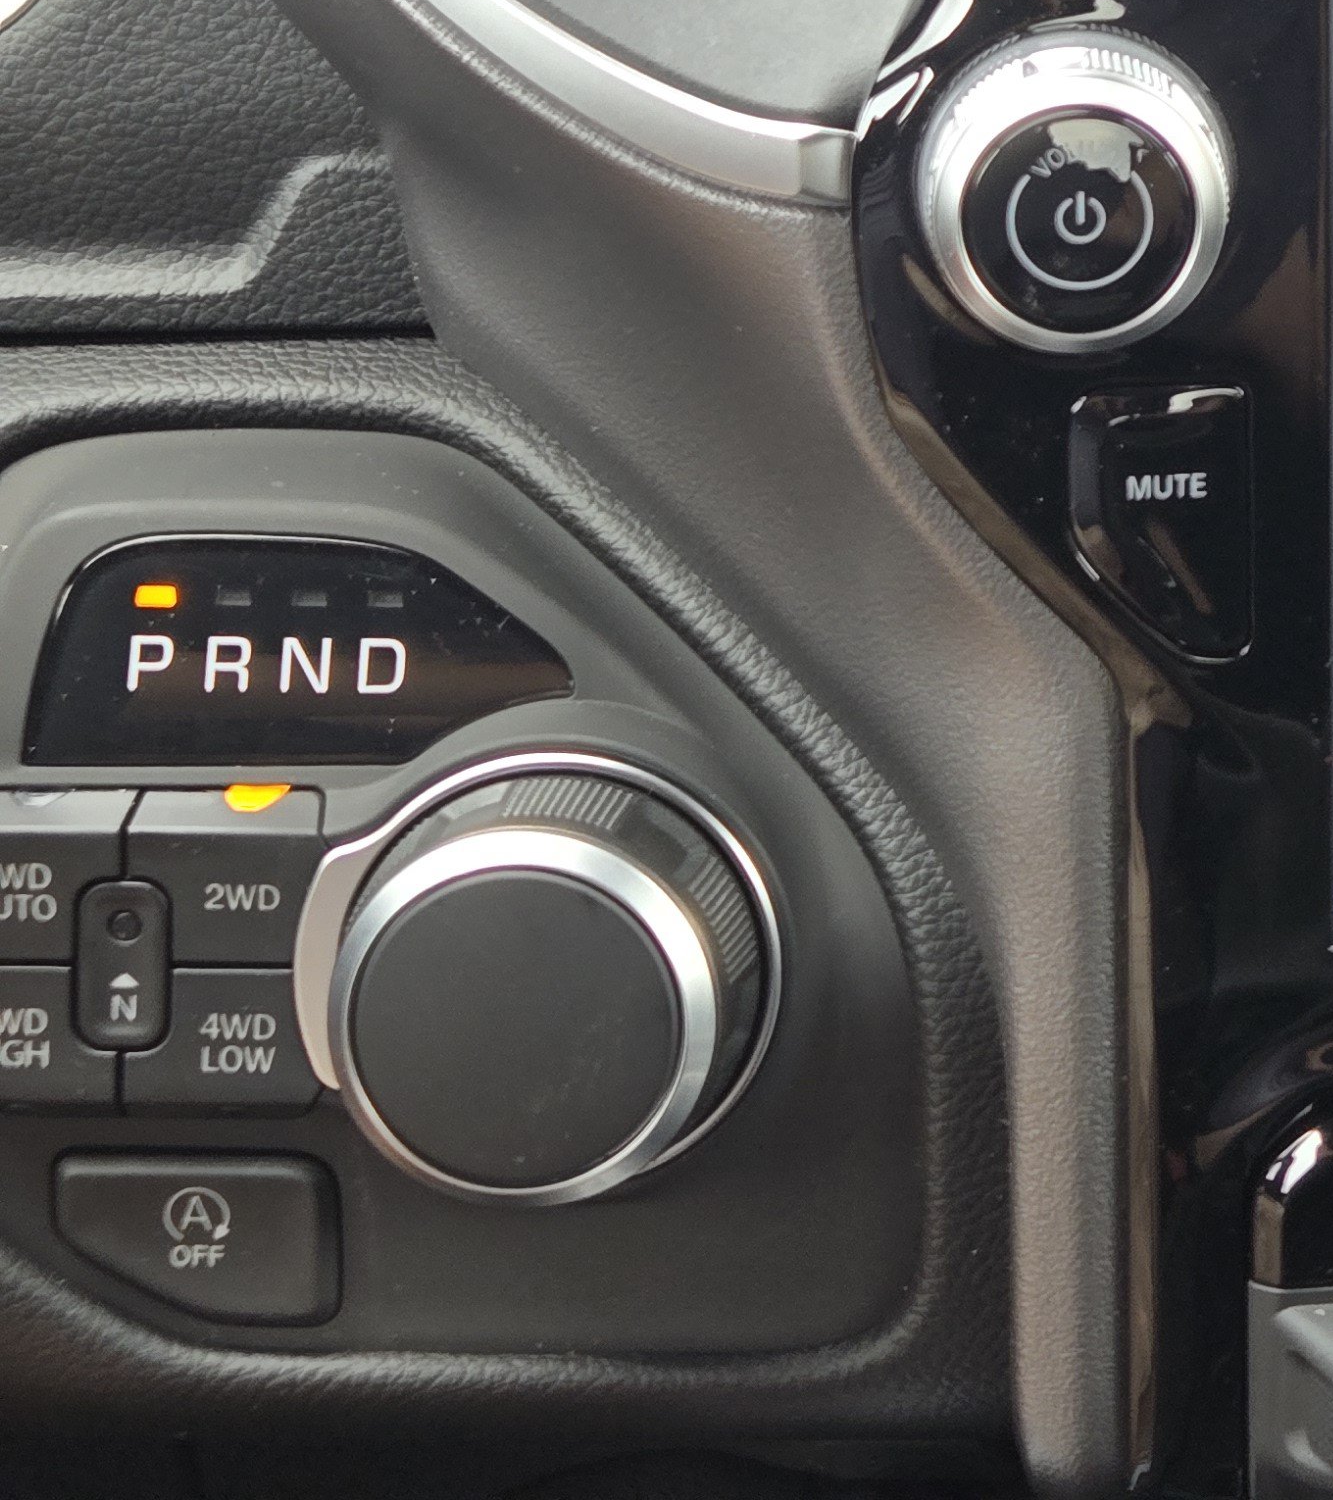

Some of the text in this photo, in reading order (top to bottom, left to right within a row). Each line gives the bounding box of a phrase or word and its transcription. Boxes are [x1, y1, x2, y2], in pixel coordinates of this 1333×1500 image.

[1125, 472, 1208, 501] MUTE
[126, 634, 407, 695] P R N D
[203, 882, 281, 912] 2WD
[109, 993, 138, 1022] N
[199, 1012, 277, 1041] 4WD
[199, 1045, 277, 1075] LOW
[168, 1243, 226, 1270] OFF
